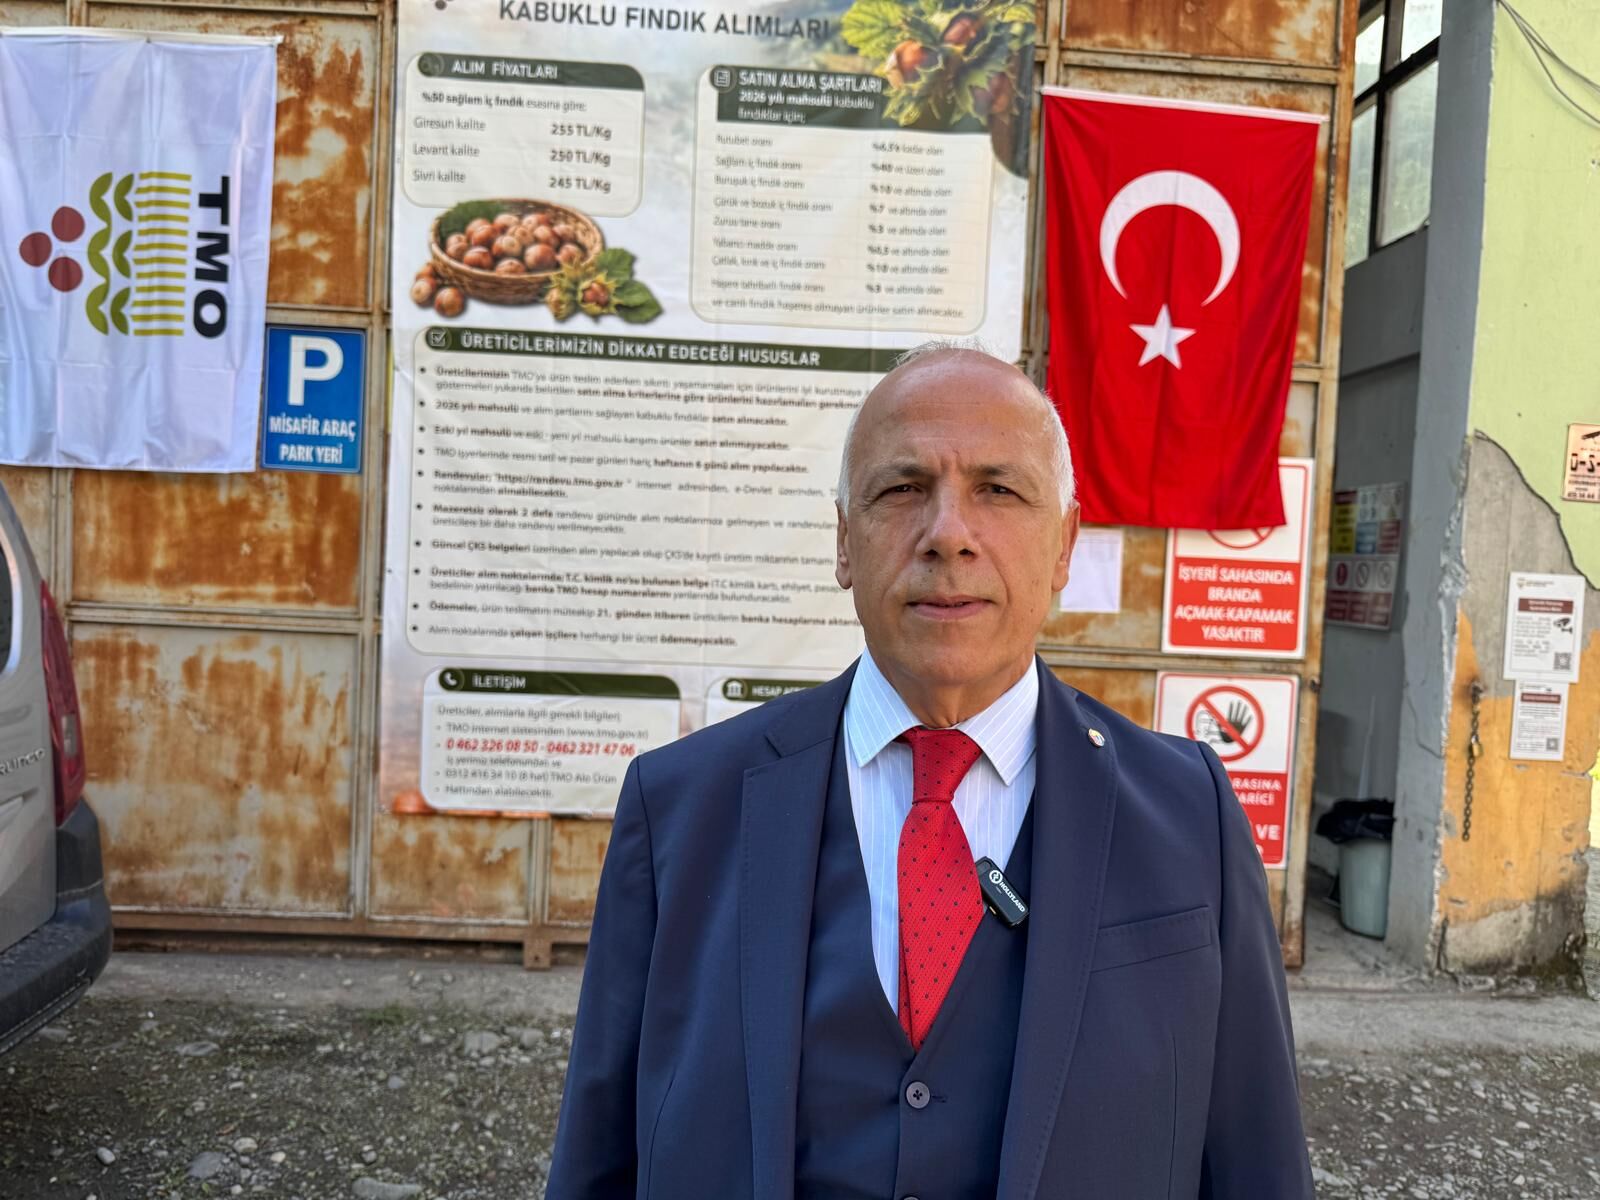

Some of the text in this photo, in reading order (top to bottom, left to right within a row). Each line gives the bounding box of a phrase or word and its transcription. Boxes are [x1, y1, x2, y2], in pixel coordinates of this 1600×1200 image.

[500, 0, 829, 40] KABUKLU FINDIK ALIMLARI
[451, 59, 558, 80] ALIM FİYATLARI
[739, 70, 882, 93] SATIN ALMA ŞARTLARI
[422, 91, 444, 103] %50
[446, 93, 483, 107] sağlam
[485, 95, 493, 108] iç
[494, 95, 524, 107] fındık
[739, 90, 874, 109] 2026 yılı mahsulü kabuklu
[737, 107, 782, 120] fındıklar
[414, 116, 486, 131] Giresun kalite
[551, 124, 612, 140] 255 TL/Kg
[413, 144, 480, 158] Levant kalite
[550, 150, 611, 167] 250 TL/Kg
[412, 170, 466, 184] Sivri kalite
[549, 177, 611, 193] 245 TL/Kg
[193, 176, 230, 339] TMO
[461, 332, 820, 366] ÜRETİCİLERİMİZİN DİKKAT EDECEĞİ HUSUSLAR
[287, 335, 345, 406] P
[436, 366, 509, 378] Üreticilerimizin
[478, 403, 519, 413] mahsulü
[269, 412, 356, 443] MİSAFİR ARAÇ
[279, 442, 343, 464] PARK YERİ
[433, 504, 484, 515] Mazeretsiz
[488, 506, 518, 516] olarak
[432, 539, 465, 550] Güncel
[467, 540, 486, 552] ÇKS
[1178, 561, 1295, 585] İŞYERİ SAHASINDA
[1207, 586, 1263, 603] BRANDA
[1174, 604, 1295, 624] AÇMAK-KAPAMAK
[1201, 624, 1266, 643] YASAKTIR
[472, 673, 526, 690] İLETİŞİM
[751, 686, 781, 697] HESAP
[447, 722, 470, 732] TMO
[446, 738, 635, 756] 0 462 326 08 50 0462 321 47 06
[1231, 777, 1282, 791] RASINA
[1236, 791, 1275, 806] ARİCİ
[1255, 824, 1280, 841] VE
[999, 881, 1026, 913] HOLLYLAND
